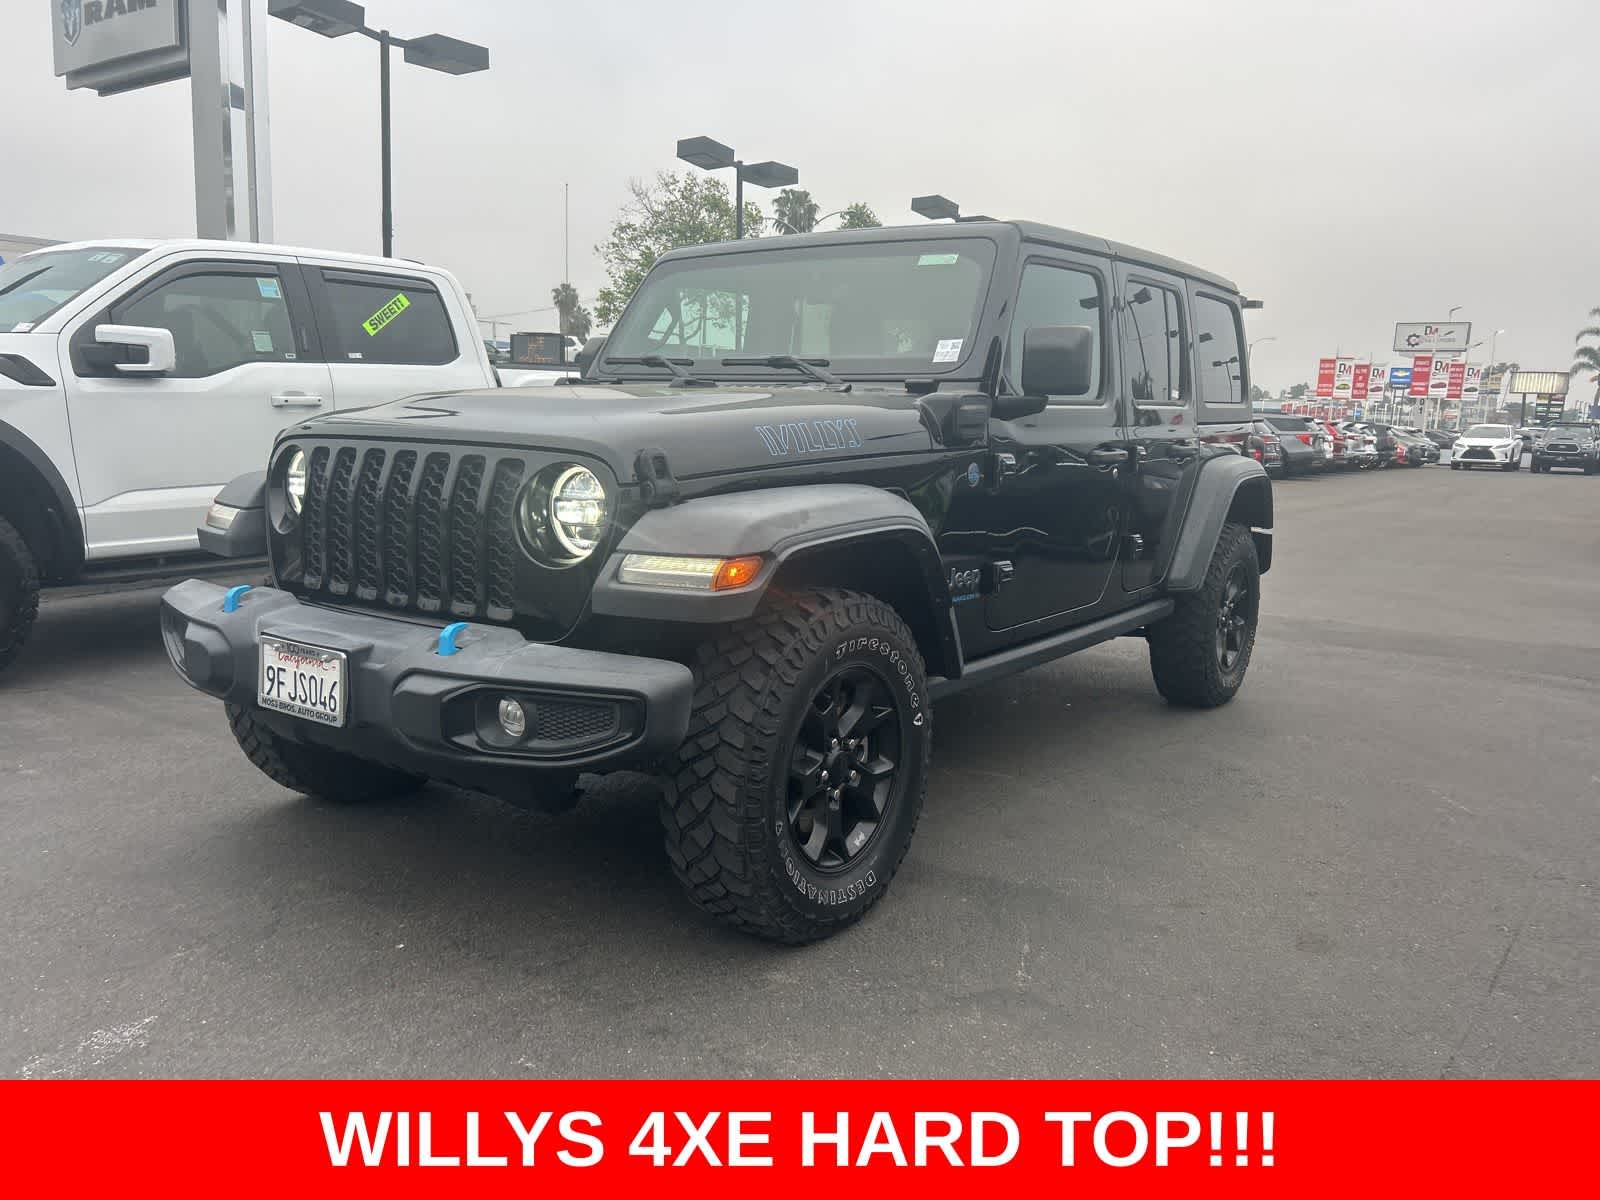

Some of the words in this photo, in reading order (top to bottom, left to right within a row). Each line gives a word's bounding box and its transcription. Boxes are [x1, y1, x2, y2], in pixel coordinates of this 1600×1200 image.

[368, 297, 405, 331] SWEET!
[755, 416, 864, 457] WILLYS
[947, 567, 981, 591] Jeep
[835, 637, 920, 709] Firestone
[297, 706, 315, 718] AUTO
[315, 711, 338, 724] GROUP
